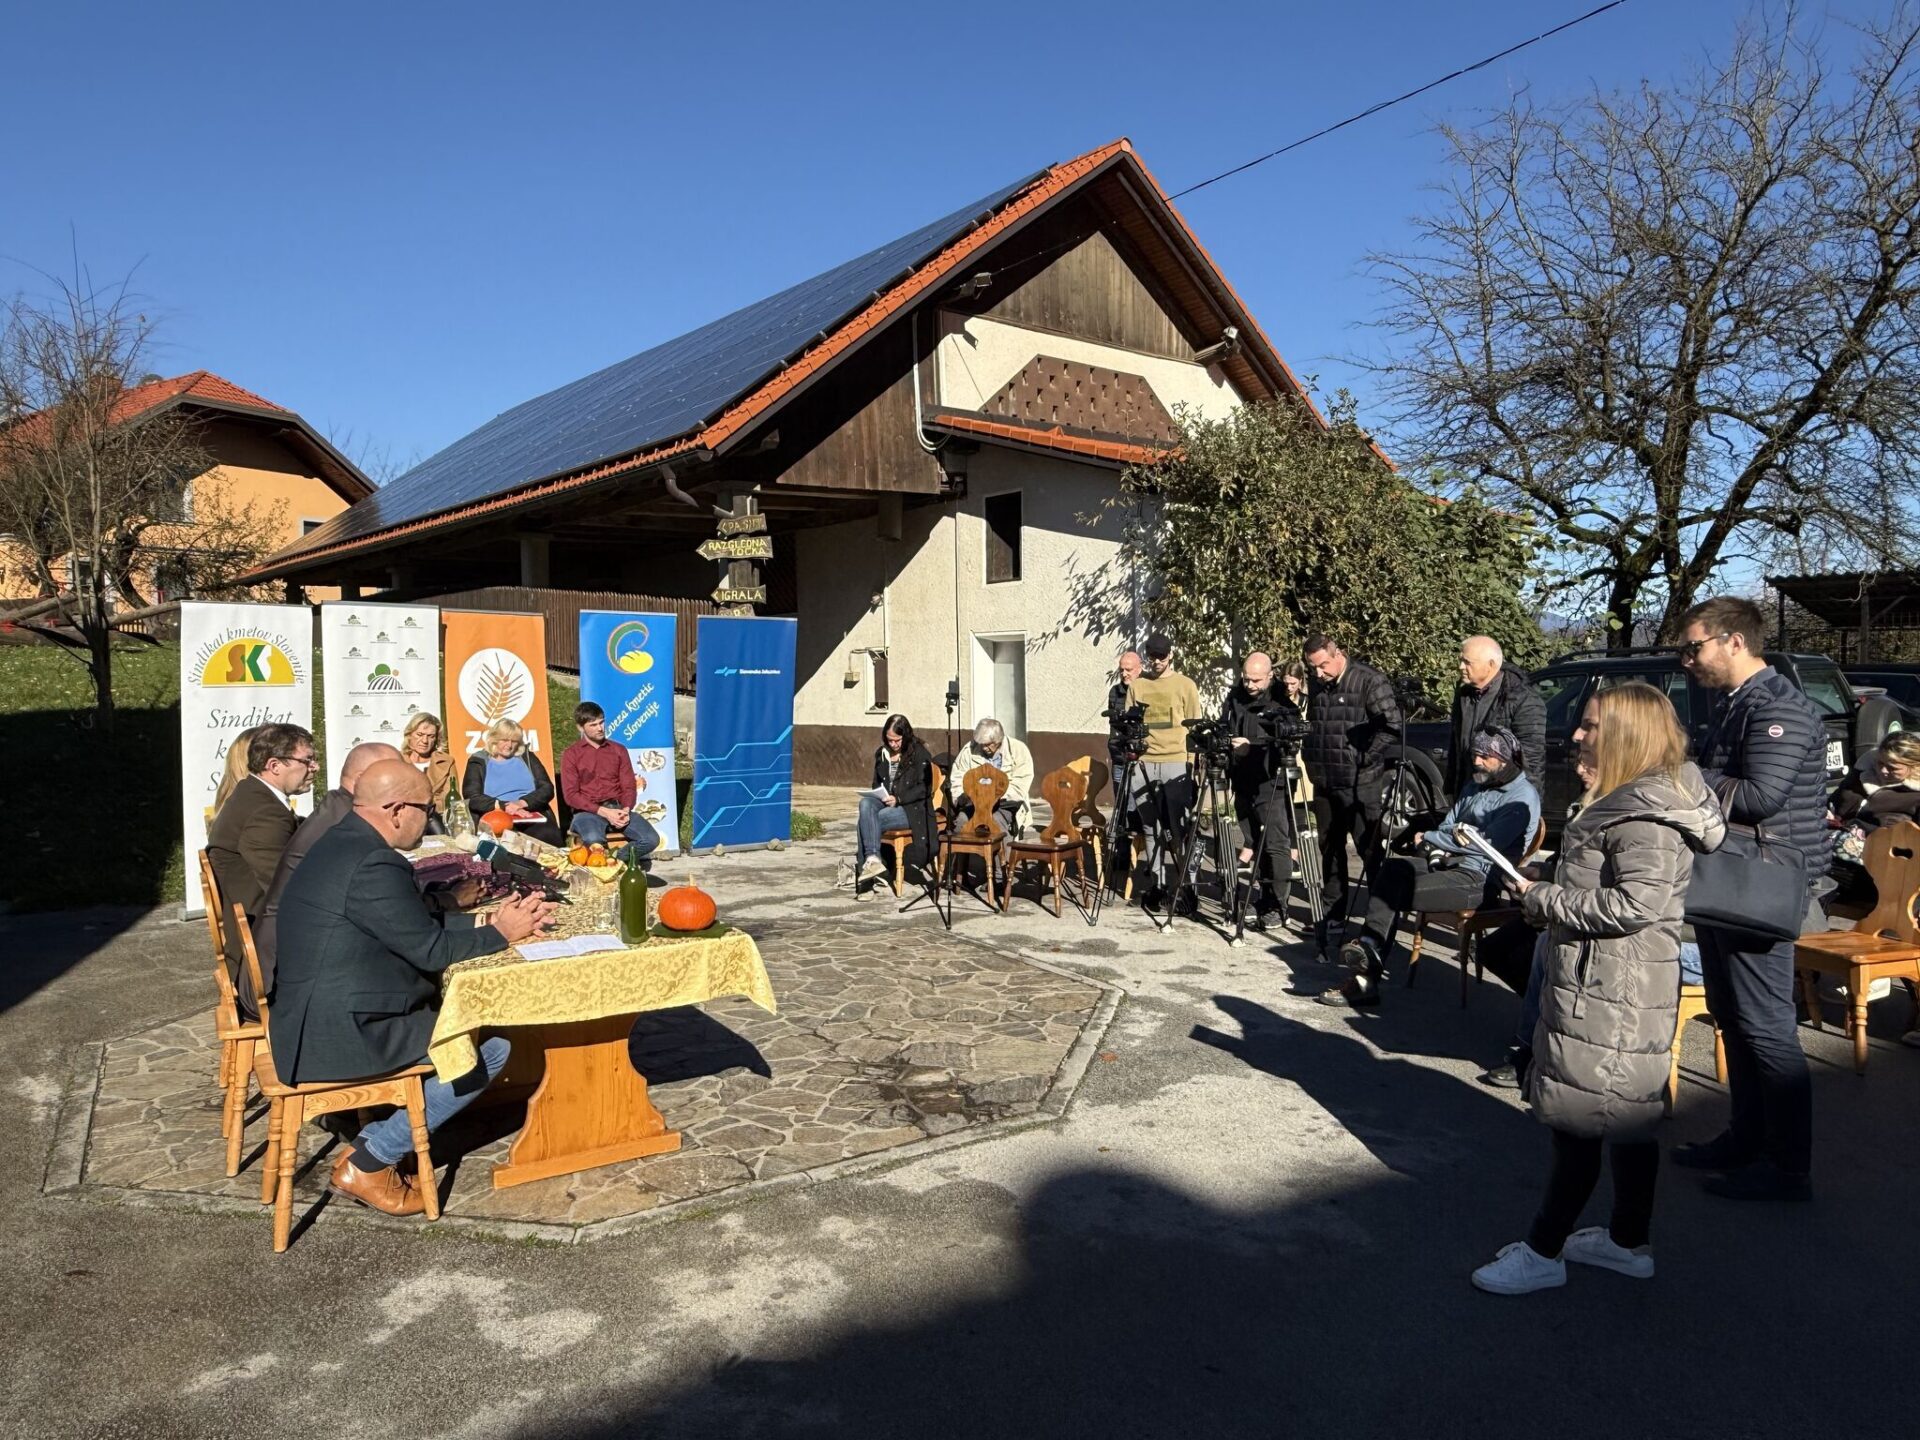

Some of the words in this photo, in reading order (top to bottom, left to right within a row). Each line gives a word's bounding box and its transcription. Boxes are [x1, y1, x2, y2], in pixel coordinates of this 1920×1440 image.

[721, 589, 762, 601] IGRALA
[188, 633, 225, 684] Sindikat
[226, 626, 272, 641] kmetov
[271, 633, 307, 685] Slovenije
[207, 706, 293, 729] Sindikat
[623, 701, 660, 741] Slovenije
